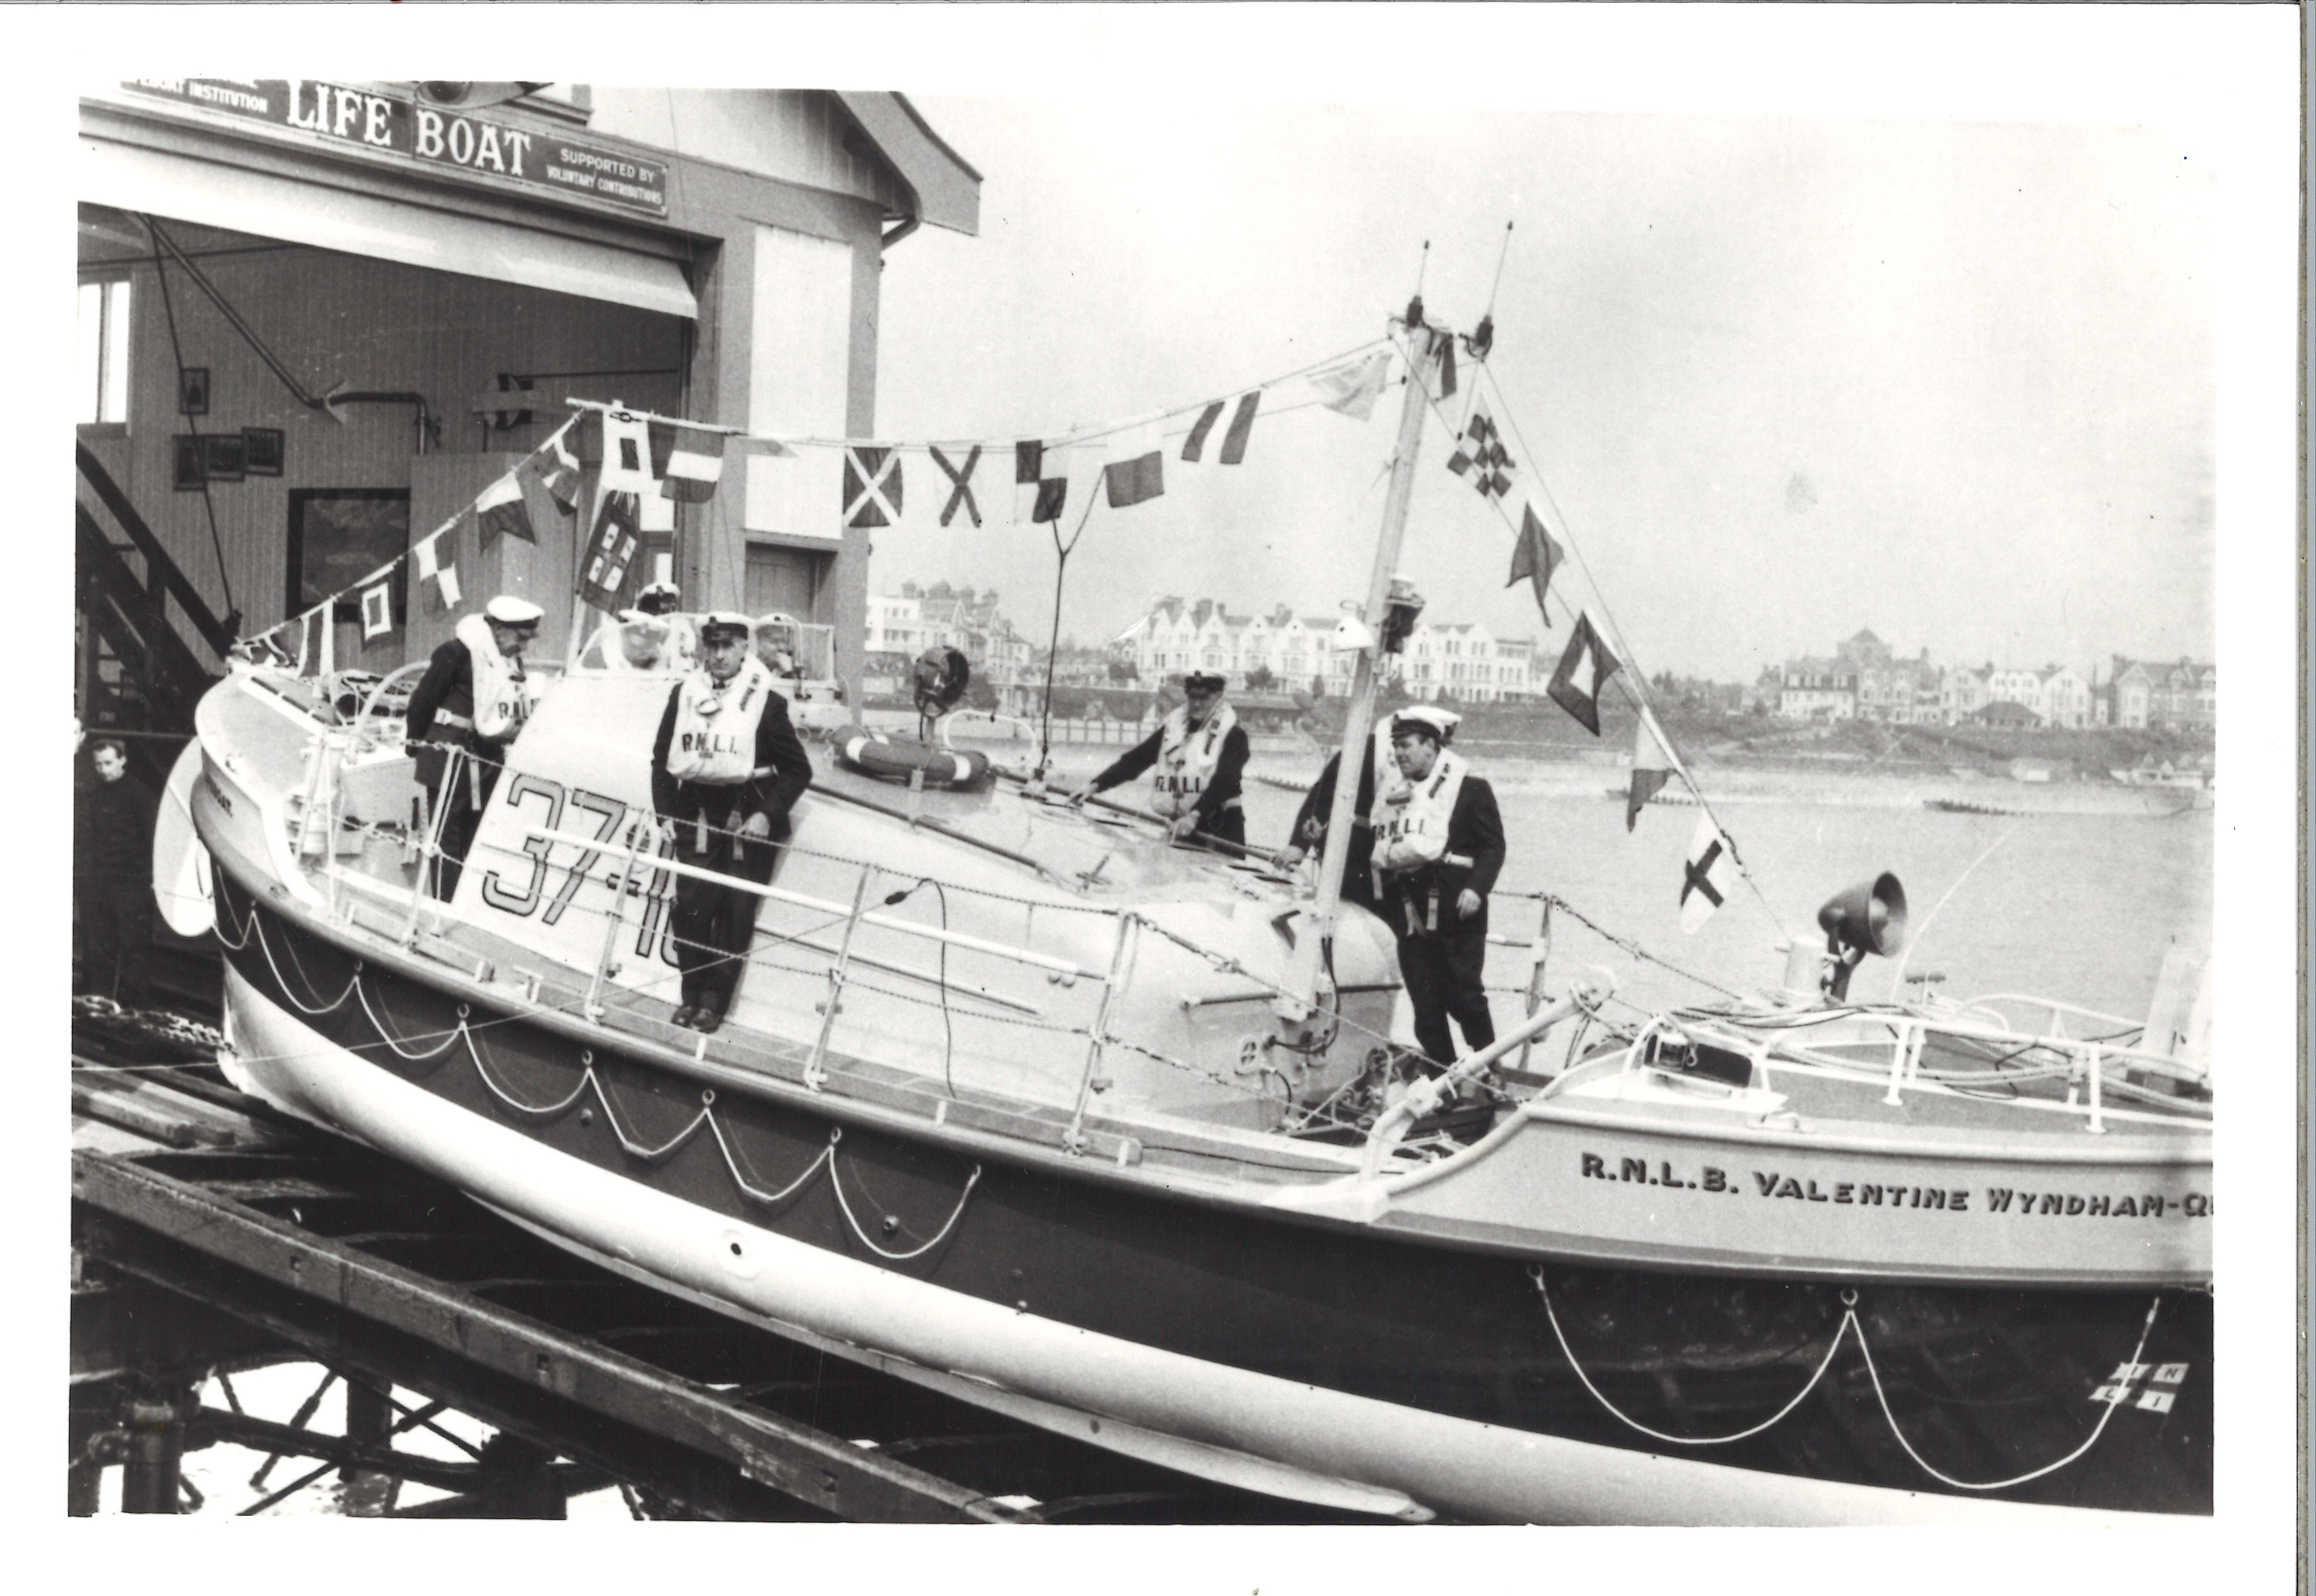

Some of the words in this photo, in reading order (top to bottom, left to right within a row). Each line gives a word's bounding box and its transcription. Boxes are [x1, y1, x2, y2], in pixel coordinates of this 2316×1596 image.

[189, 80, 268, 113] INSTITUTION
[287, 80, 392, 147] LIFE
[416, 109, 530, 175] BOAT
[547, 164, 595, 188] VOLUNTARY
[597, 177, 662, 204] CONTRIBUTIONS
[560, 148, 635, 179] SUPPORTED
[638, 167, 655, 182] BY
[1582, 1152, 1739, 1194] R.N.L.B.
[1753, 1171, 1969, 1211] VALENTINE
[1986, 1187, 2213, 1217] WYNDHAM-Q
